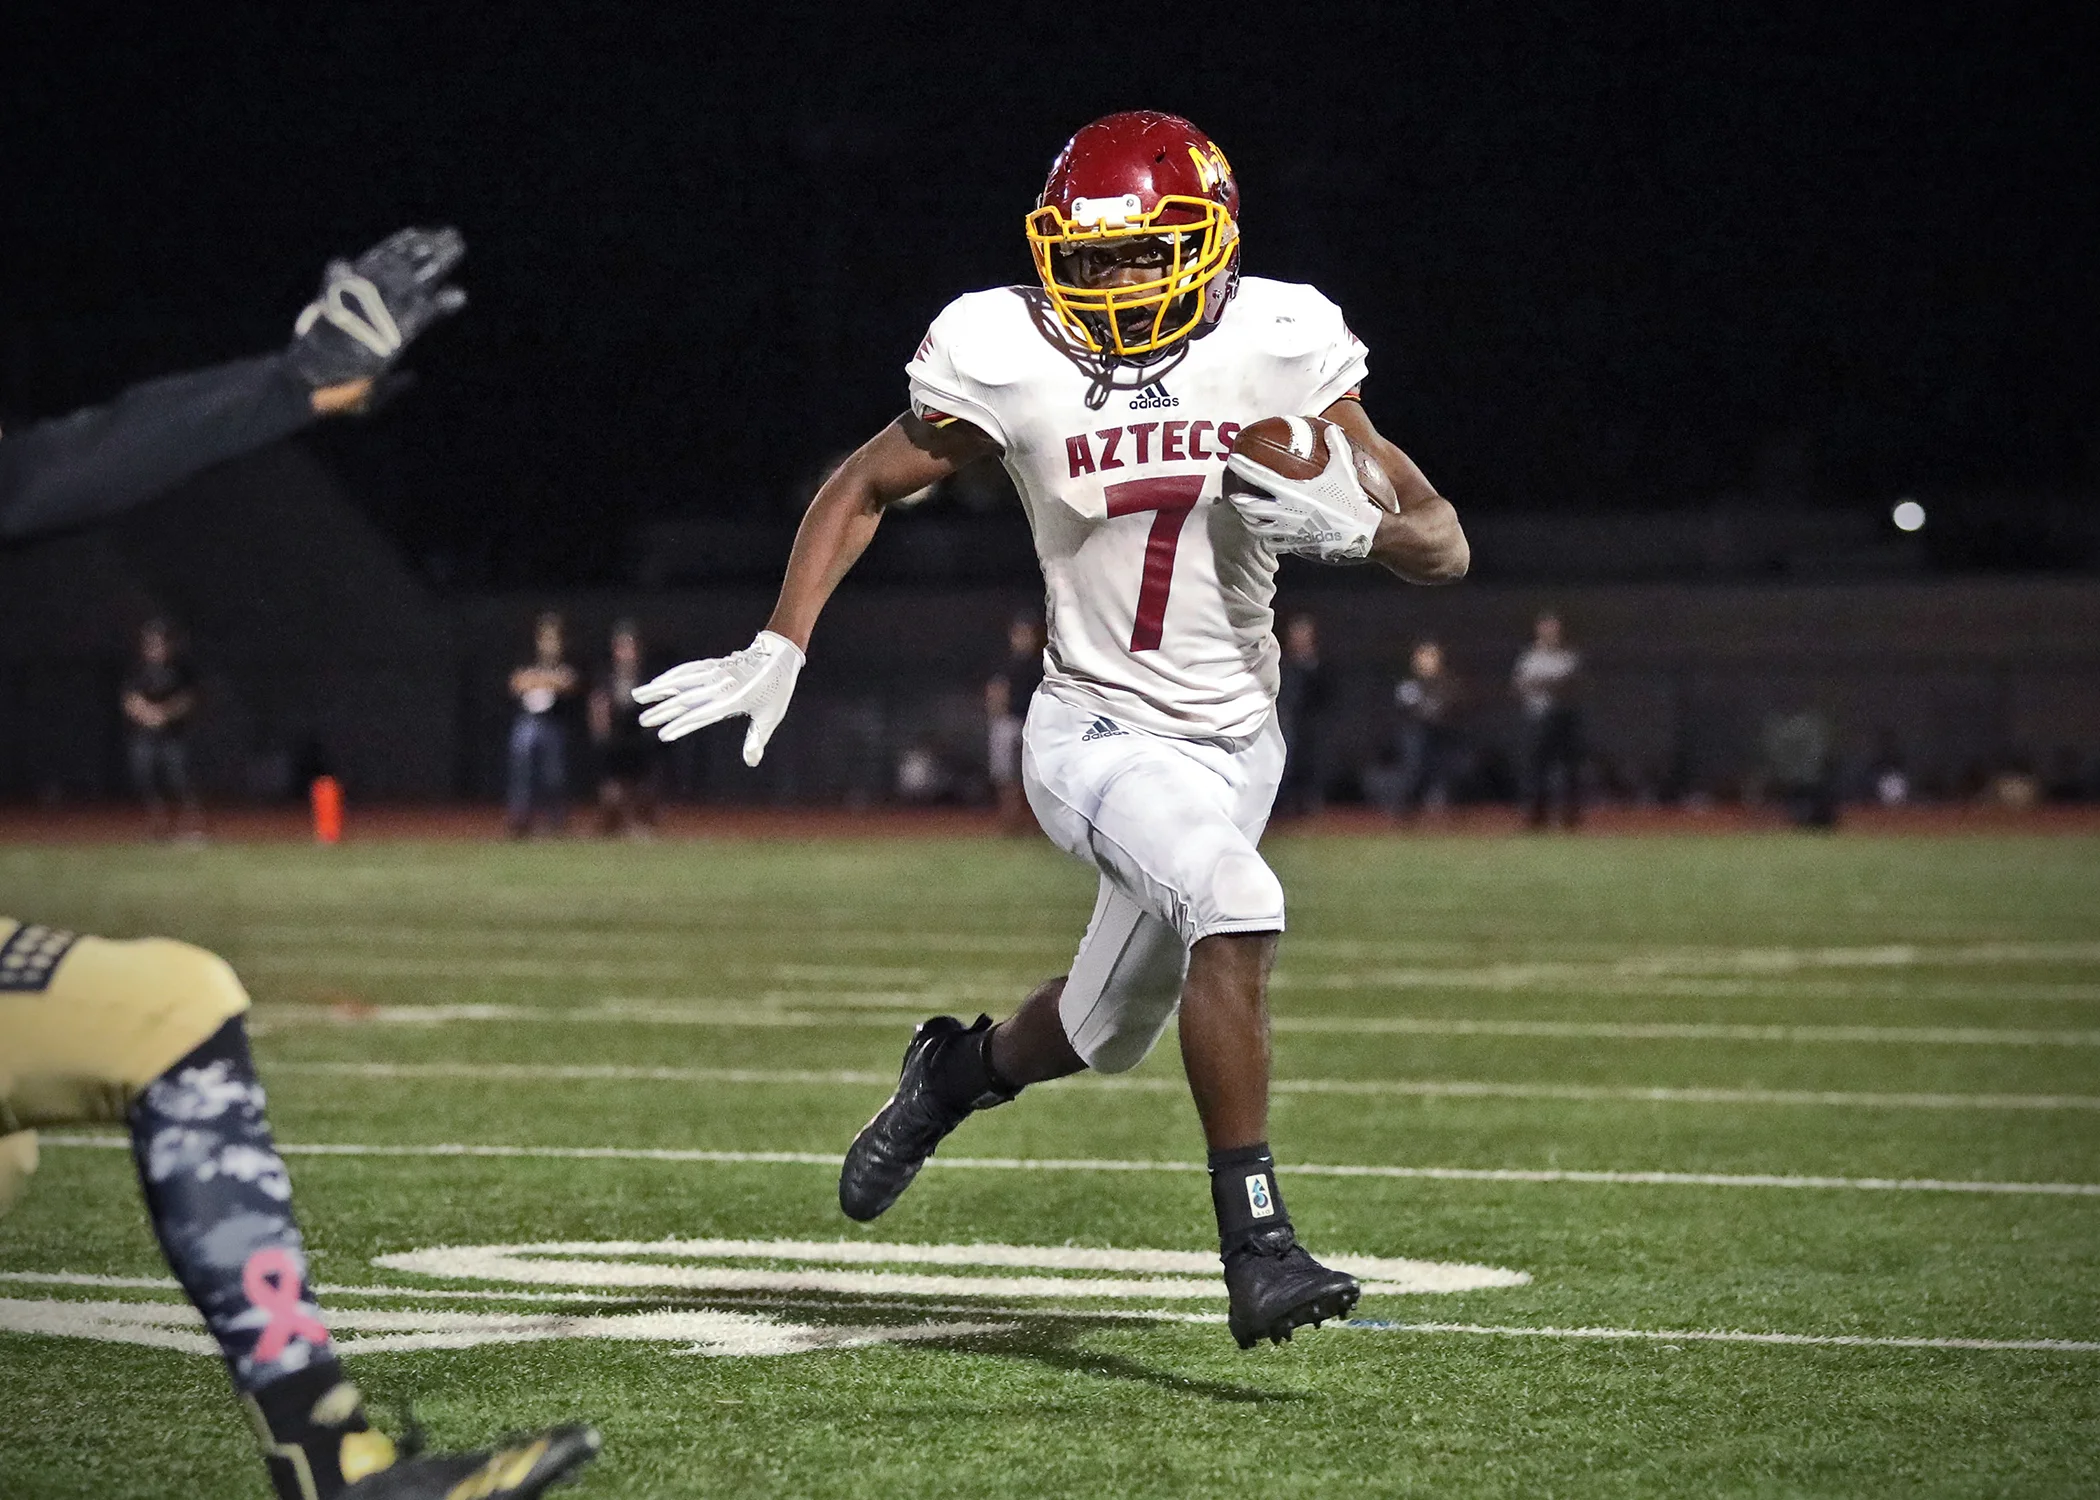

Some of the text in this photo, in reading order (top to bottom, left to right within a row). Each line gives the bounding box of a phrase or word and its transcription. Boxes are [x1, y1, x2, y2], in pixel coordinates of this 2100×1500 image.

[1129, 397, 1179, 410] adidas
[1065, 420, 1242, 478] AZTECS
[1104, 474, 1207, 652] 7
